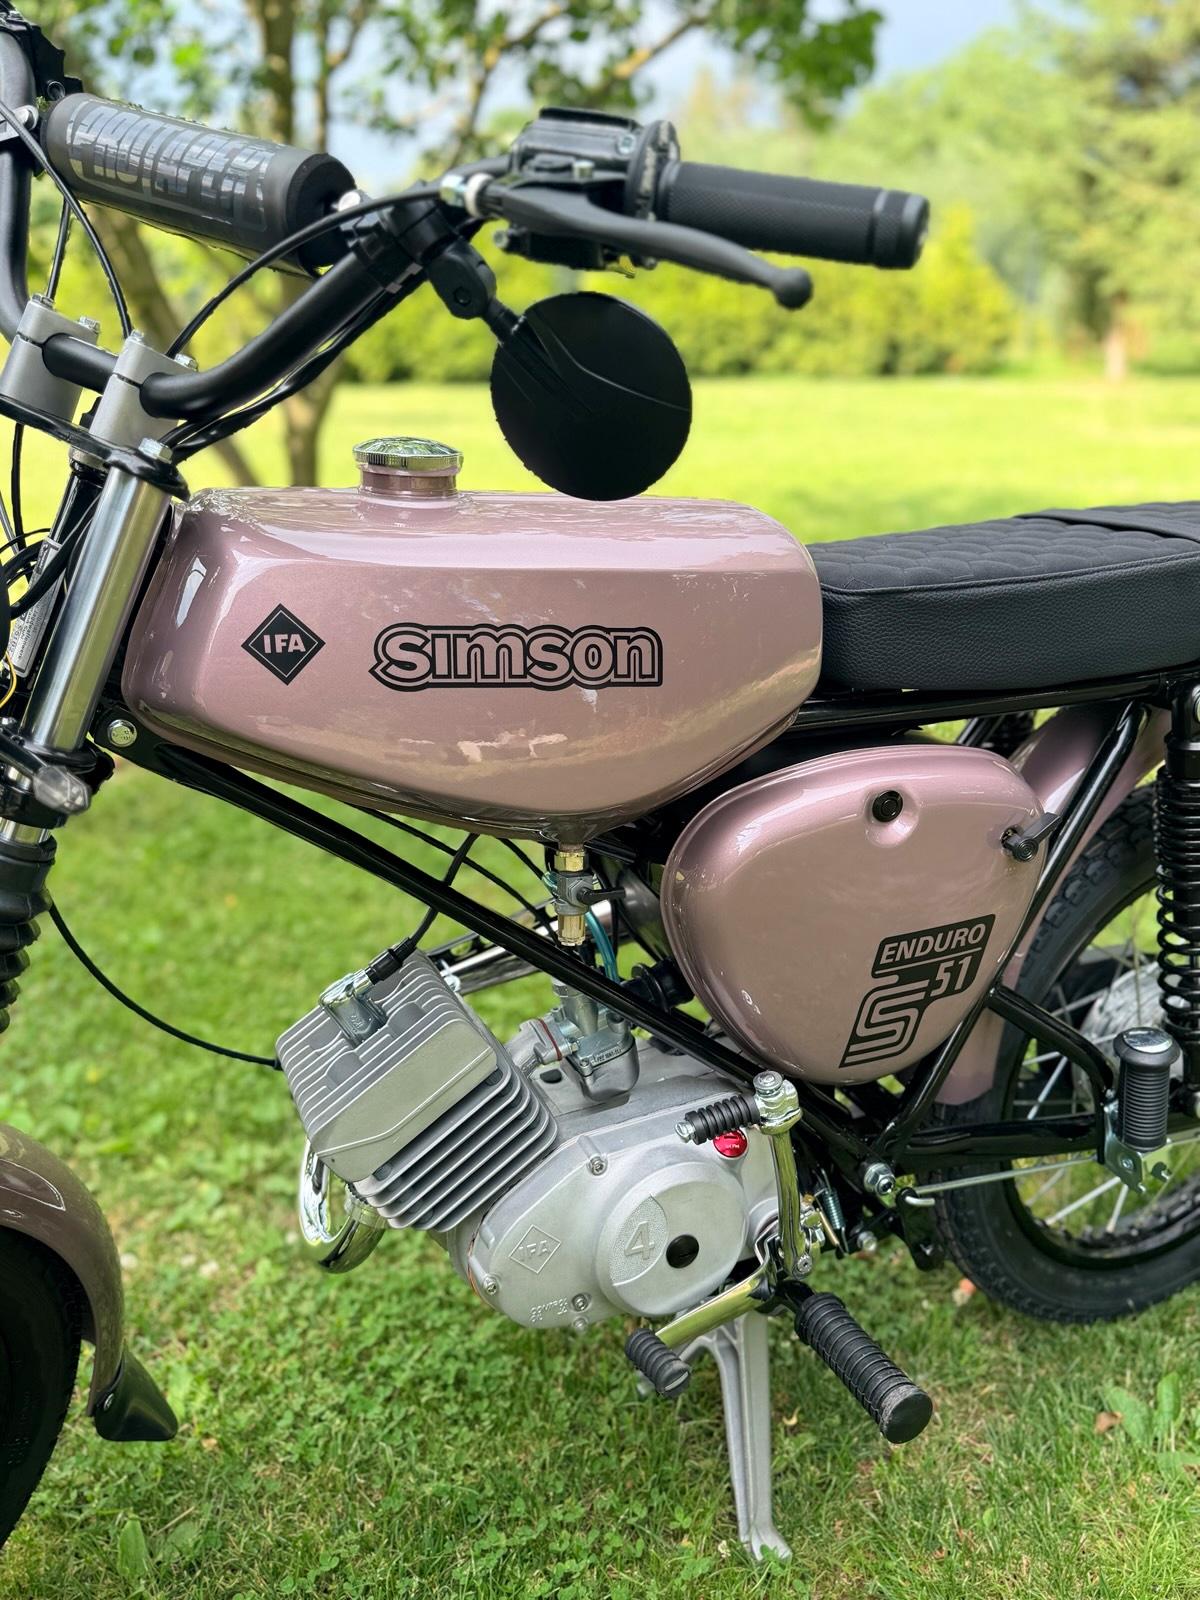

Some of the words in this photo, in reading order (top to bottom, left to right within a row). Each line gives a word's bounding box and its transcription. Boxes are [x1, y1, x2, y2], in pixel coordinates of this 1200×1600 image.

[263, 633, 306, 654] IFA
[880, 923, 986, 965] ENDURO
[624, 1220, 655, 1261] 4
